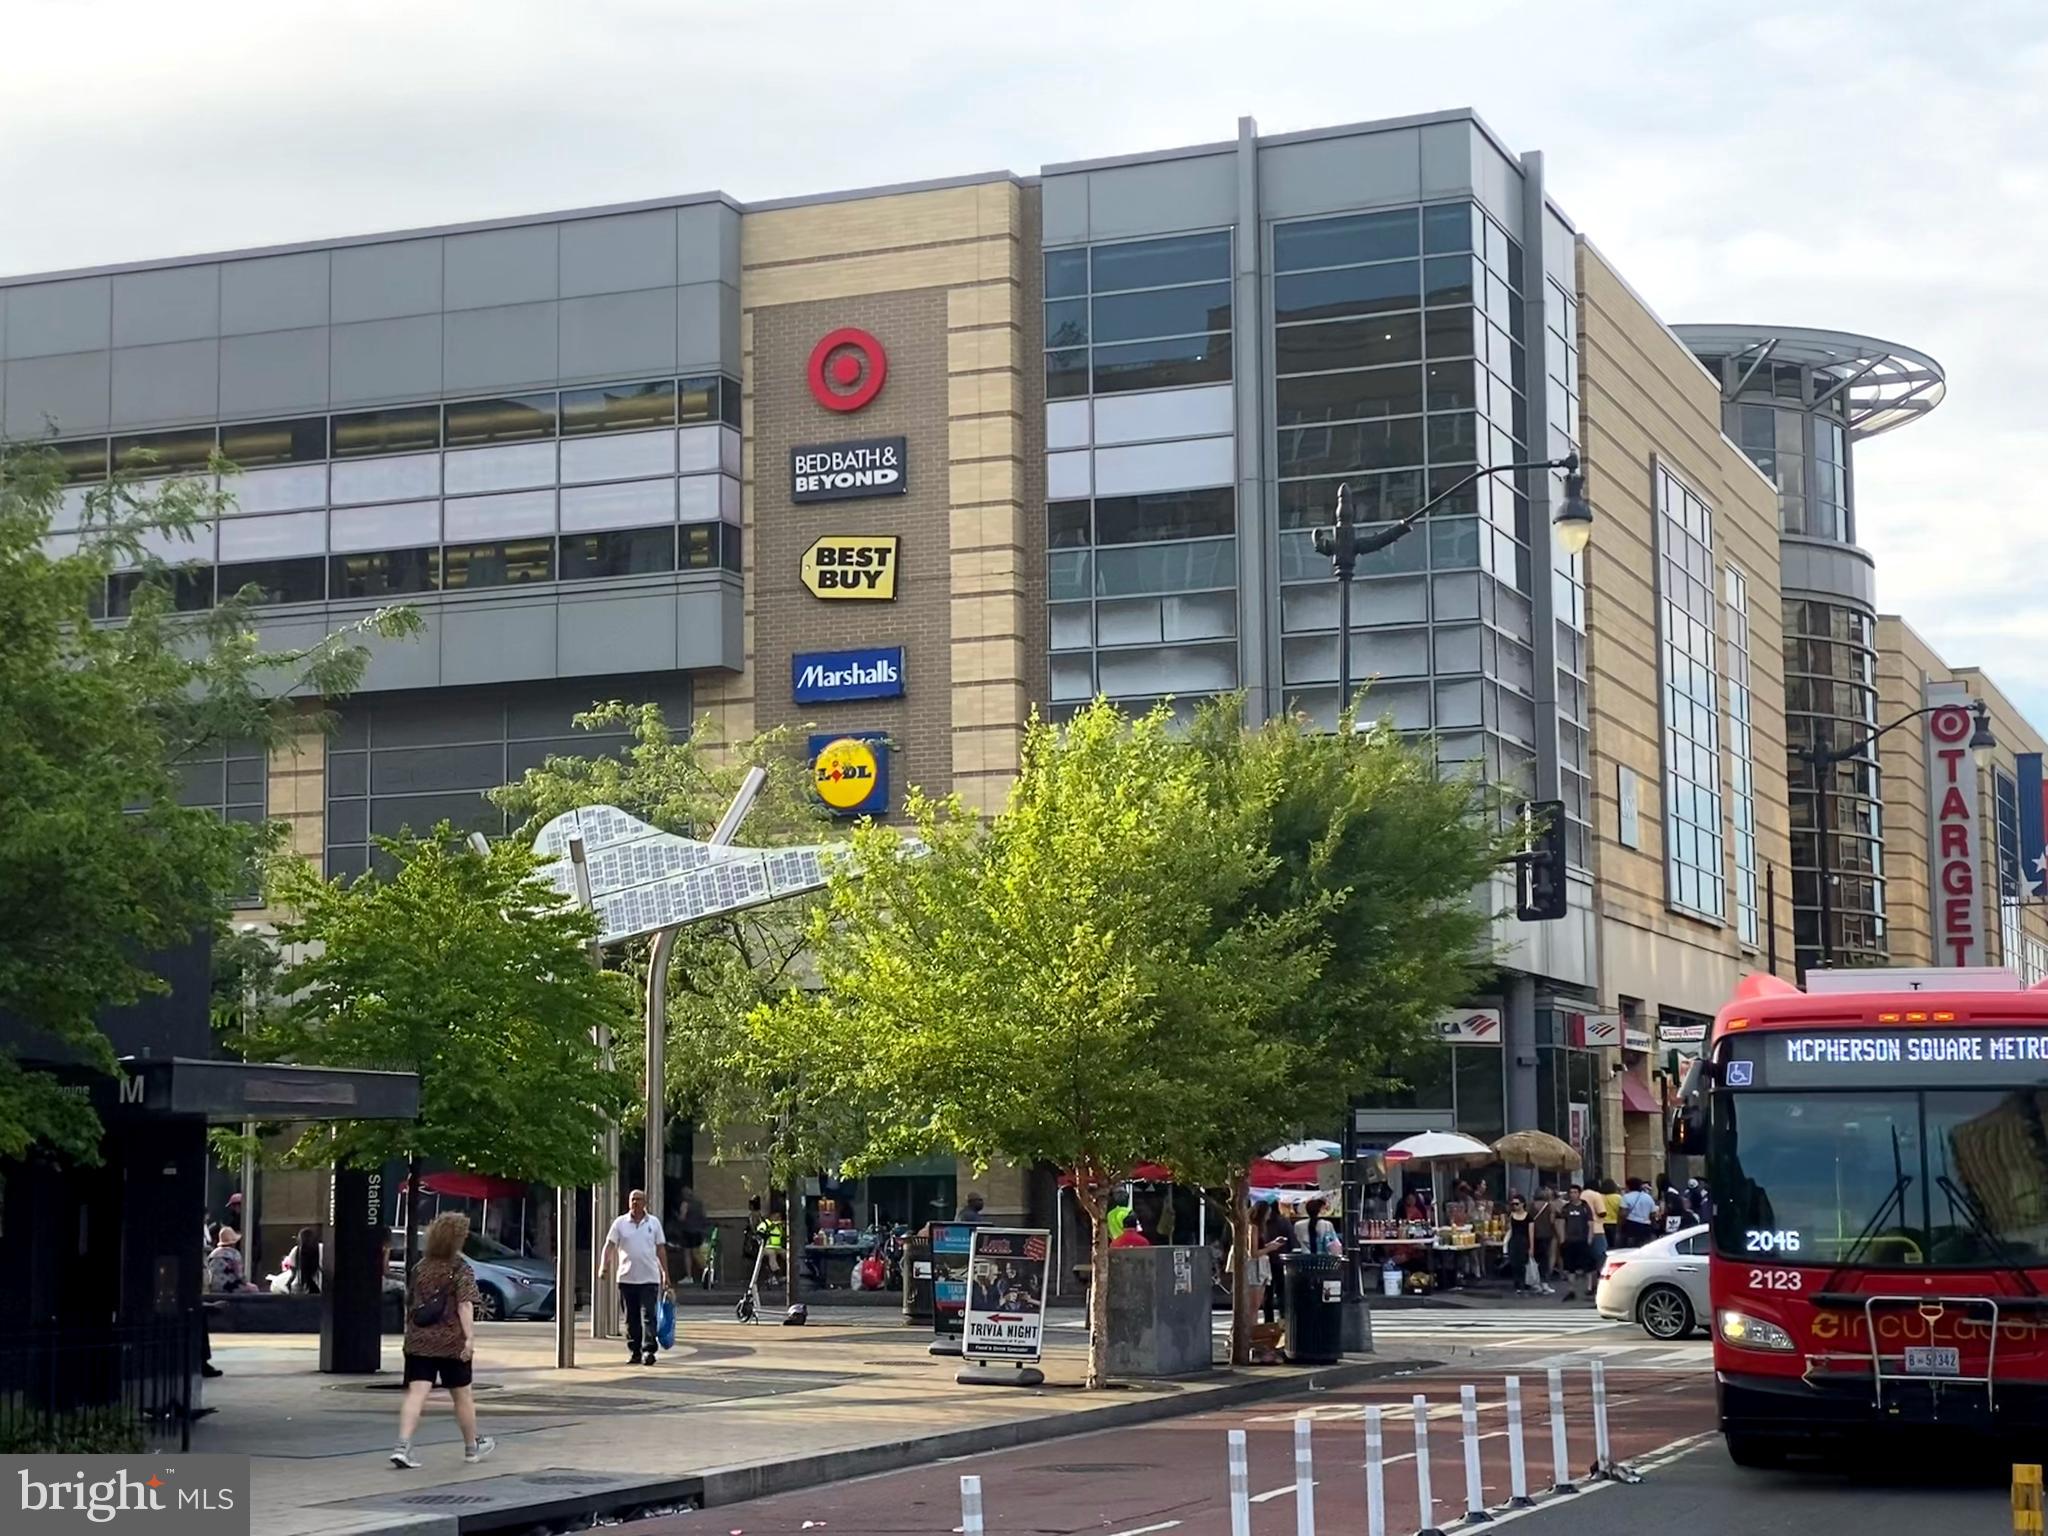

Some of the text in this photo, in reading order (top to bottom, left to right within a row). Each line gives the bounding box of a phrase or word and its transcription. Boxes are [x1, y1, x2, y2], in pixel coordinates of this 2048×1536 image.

[795, 446, 898, 474] BED BATH &
[795, 468, 899, 492] BEYOND
[816, 547, 892, 567] BEST
[818, 570, 883, 589] BUY
[797, 660, 898, 688] Marshalls
[1938, 749, 1974, 967] TARGET
[1787, 1037, 2048, 1062] MCPHERSON SQUARE METRO
[119, 1075, 145, 1103] M
[368, 1174, 382, 1226] Station
[1746, 1230, 1800, 1251] 2046
[1749, 1269, 1802, 1290] 2123
[970, 1323, 1039, 1338] TRIVIA NIGHT
[1926, 1353, 1957, 1367] 5342
